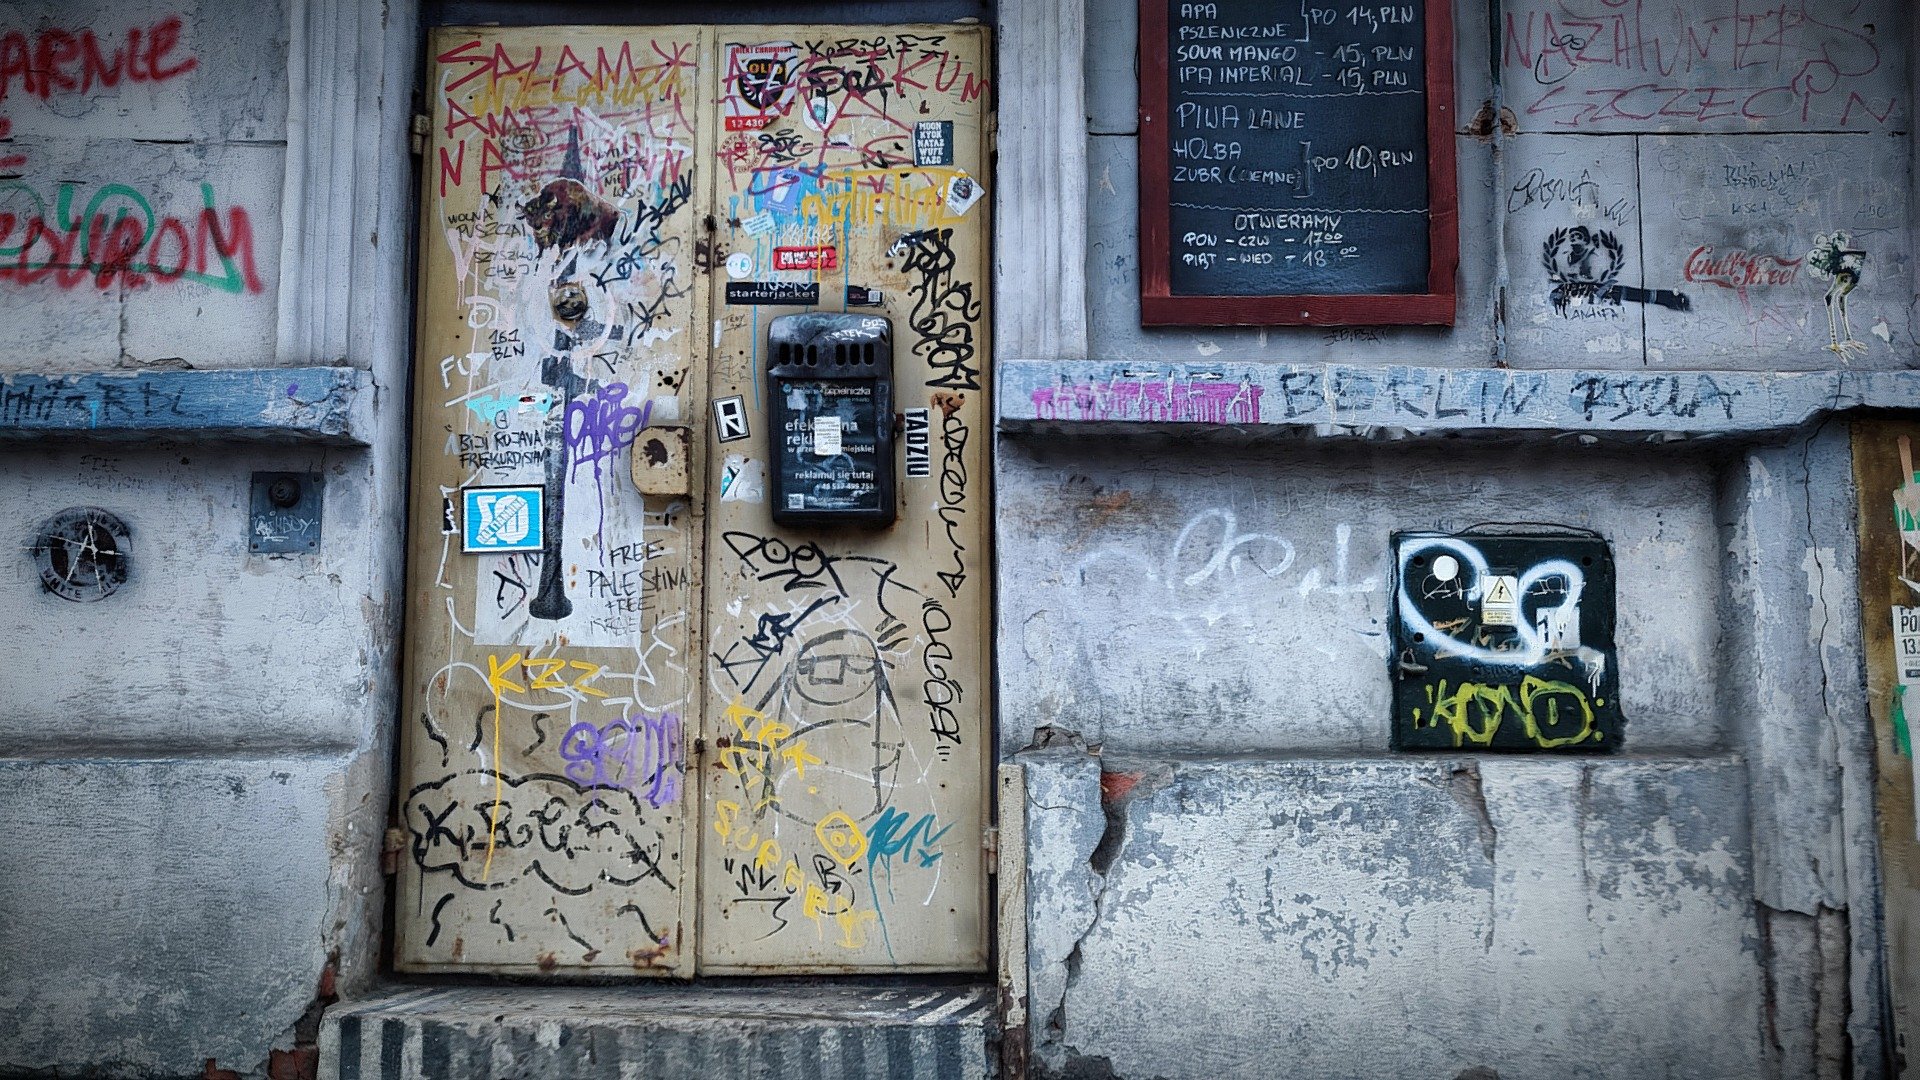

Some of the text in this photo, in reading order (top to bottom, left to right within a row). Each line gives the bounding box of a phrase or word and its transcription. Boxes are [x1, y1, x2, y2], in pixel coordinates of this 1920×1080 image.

[1181, 3, 1217, 19] APA
[1310, 8, 1337, 25] PO
[1380, 5, 1413, 24] PLN
[1179, 23, 1290, 40] PSZENICZNE
[1177, 45, 1222, 61] SOUR
[1229, 46, 1297, 62] MANGO
[1371, 46, 1413, 61] PLN
[1180, 66, 1212, 85] IPA
[1220, 64, 1312, 86] IMPERIAL
[1372, 70, 1407, 85] PLN
[1176, 102, 1239, 129] PIWA
[1173, 138, 1242, 160] HOLBA
[1313, 157, 1339, 172] PO
[1379, 150, 1413, 167] PLN
[1173, 166, 1222, 183] ZUBR
[447, 208, 494, 224] WOLNA
[1234, 214, 1341, 231] OTWIERAMY
[1183, 231, 1217, 247] PON
[1238, 236, 1270, 247] CZW
[729, 290, 815, 299] starterjacket
[488, 328, 521, 344] 161
[490, 344, 525, 360] BLN
[1279, 370, 1543, 423] BERLIN
[852, 470, 874, 481] tutaj
[609, 539, 663, 567] FREE
